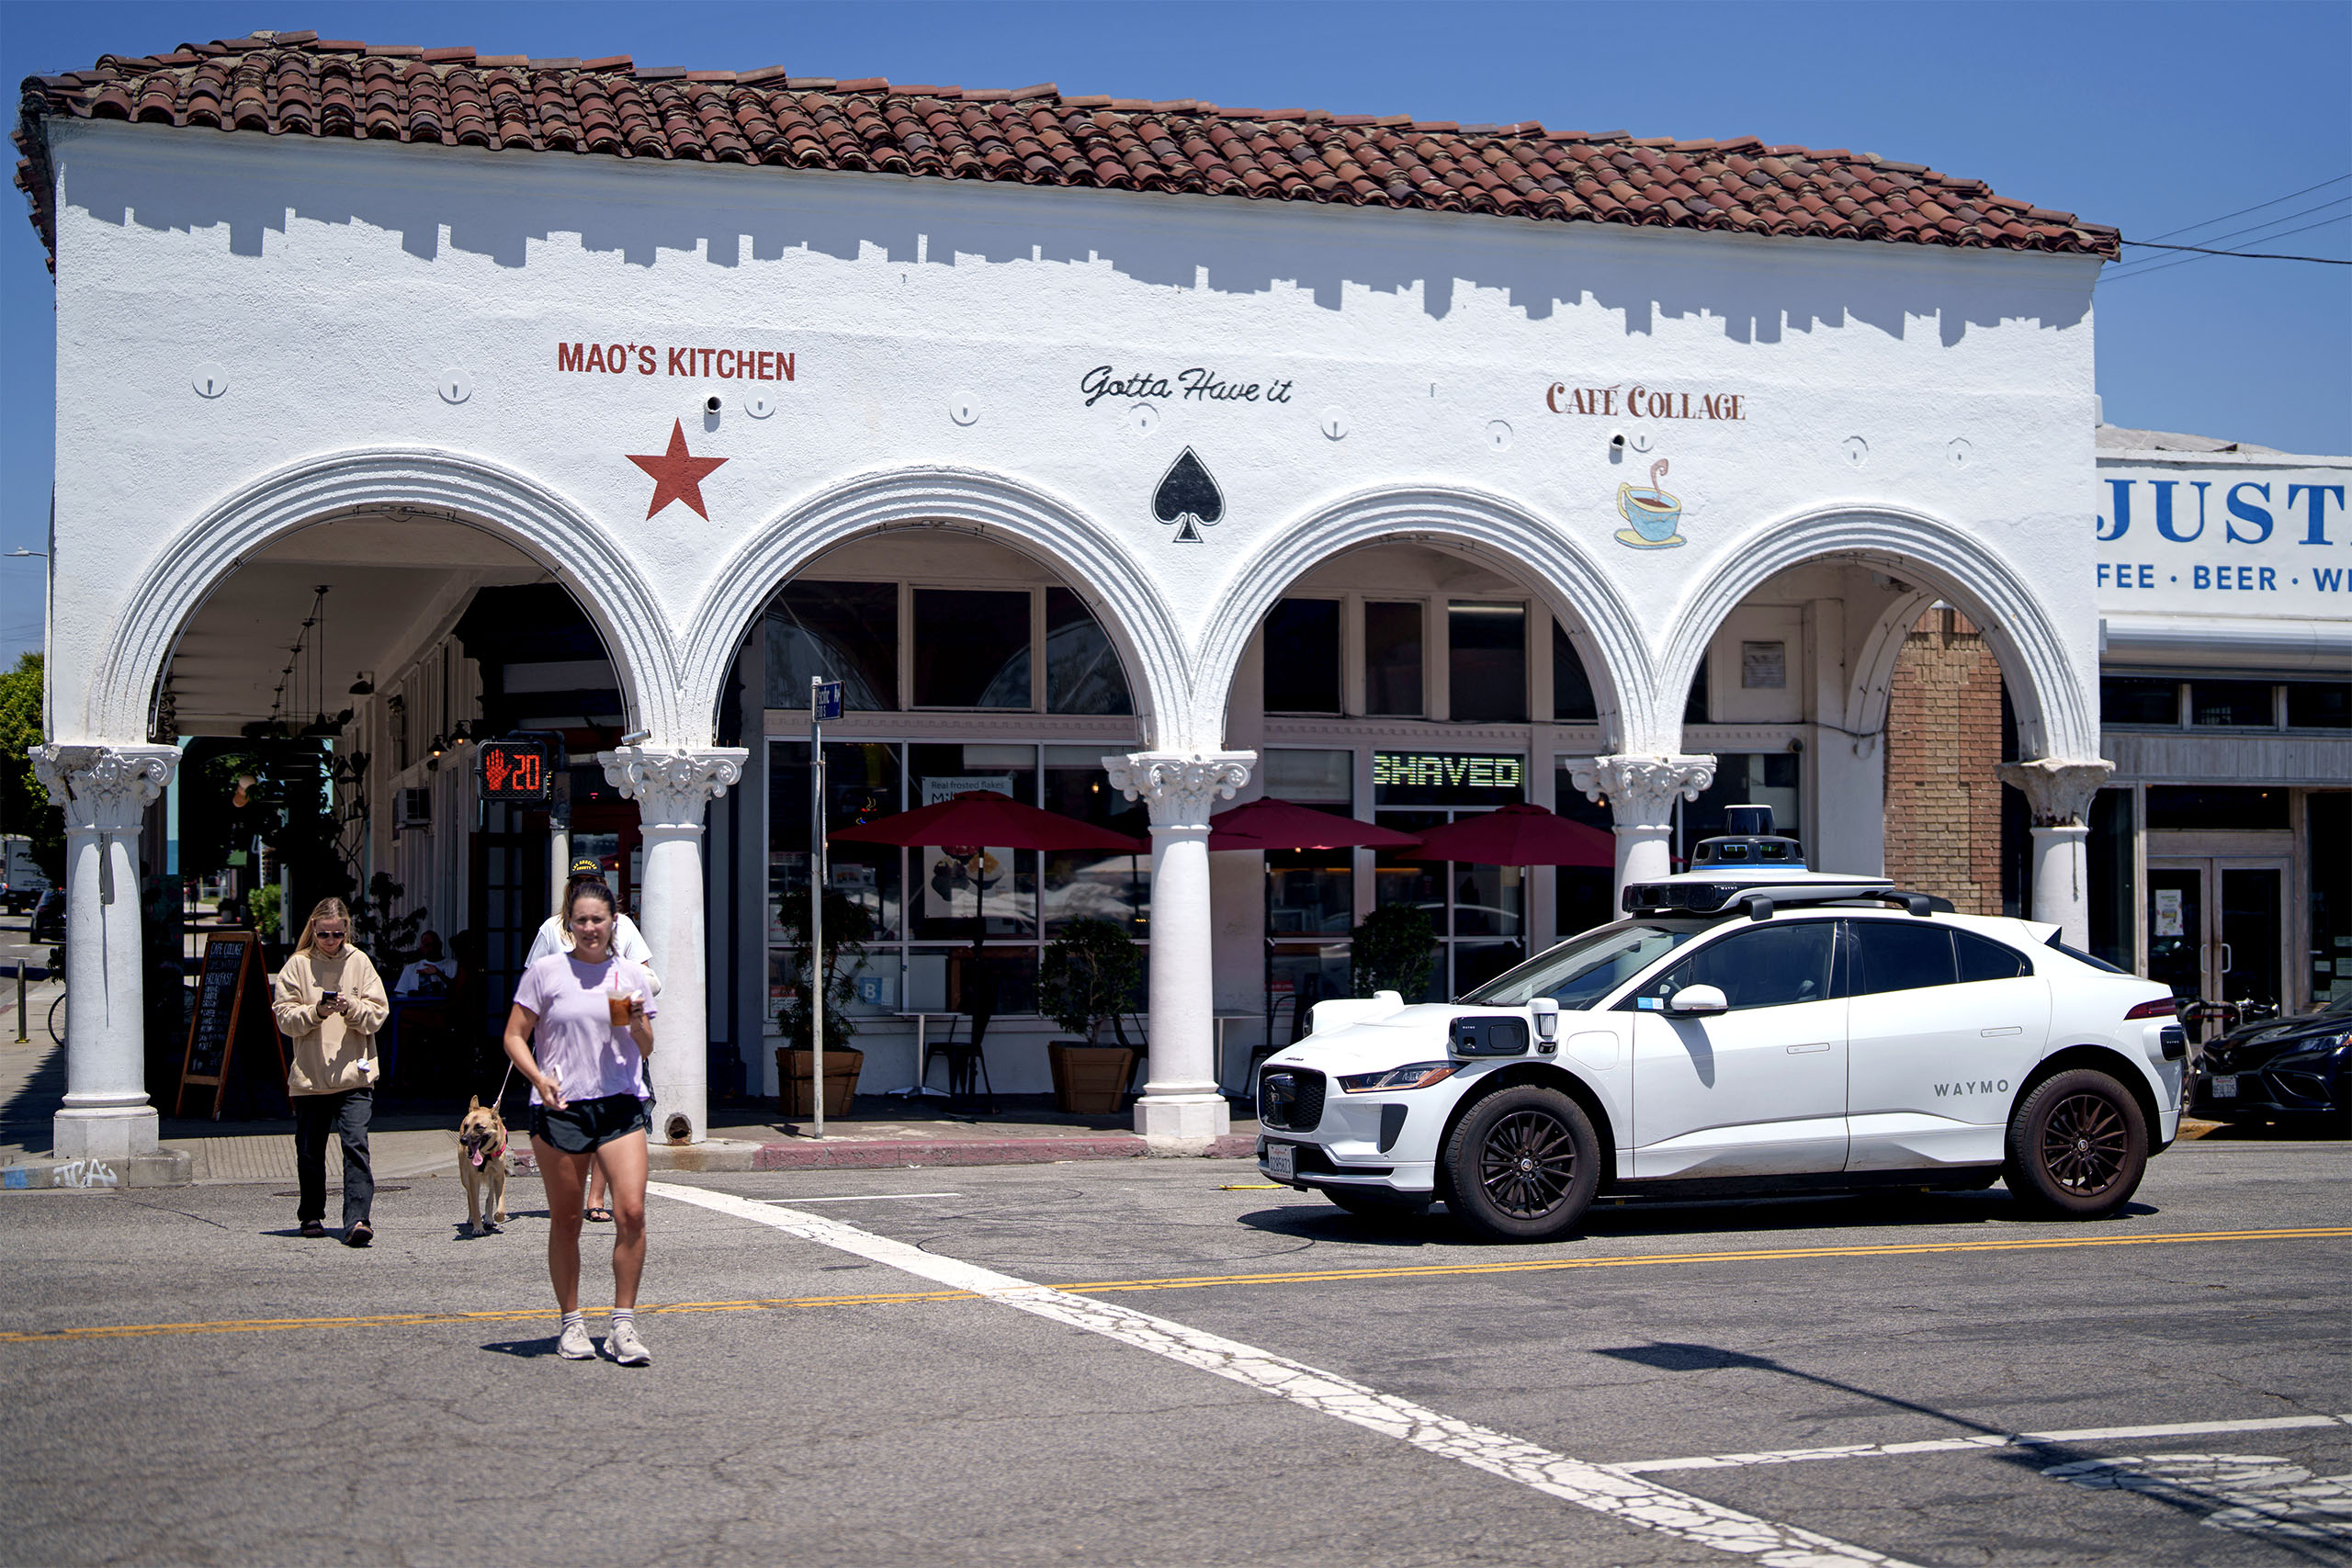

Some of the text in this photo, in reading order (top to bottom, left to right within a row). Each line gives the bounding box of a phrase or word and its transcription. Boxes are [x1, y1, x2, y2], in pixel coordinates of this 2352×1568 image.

[668, 346, 796, 381] KITCHEN
[1080, 366, 1294, 407] Gotta Have it
[1546, 381, 1747, 421] CAFÉ COLLAGE
[2097, 479, 2346, 545] JUST
[2097, 563, 2352, 592] FEE BEER WI
[512, 754, 540, 790] 20
[932, 780, 1005, 789] Real frosted flakes
[1374, 755, 1521, 787] SHAVED
[932, 792, 954, 805] Mil
[210, 942, 243, 956] CAFE COLLAGE
[205, 973, 232, 986] BREAKFAST
[1934, 1079, 2009, 1097] WAYMO
